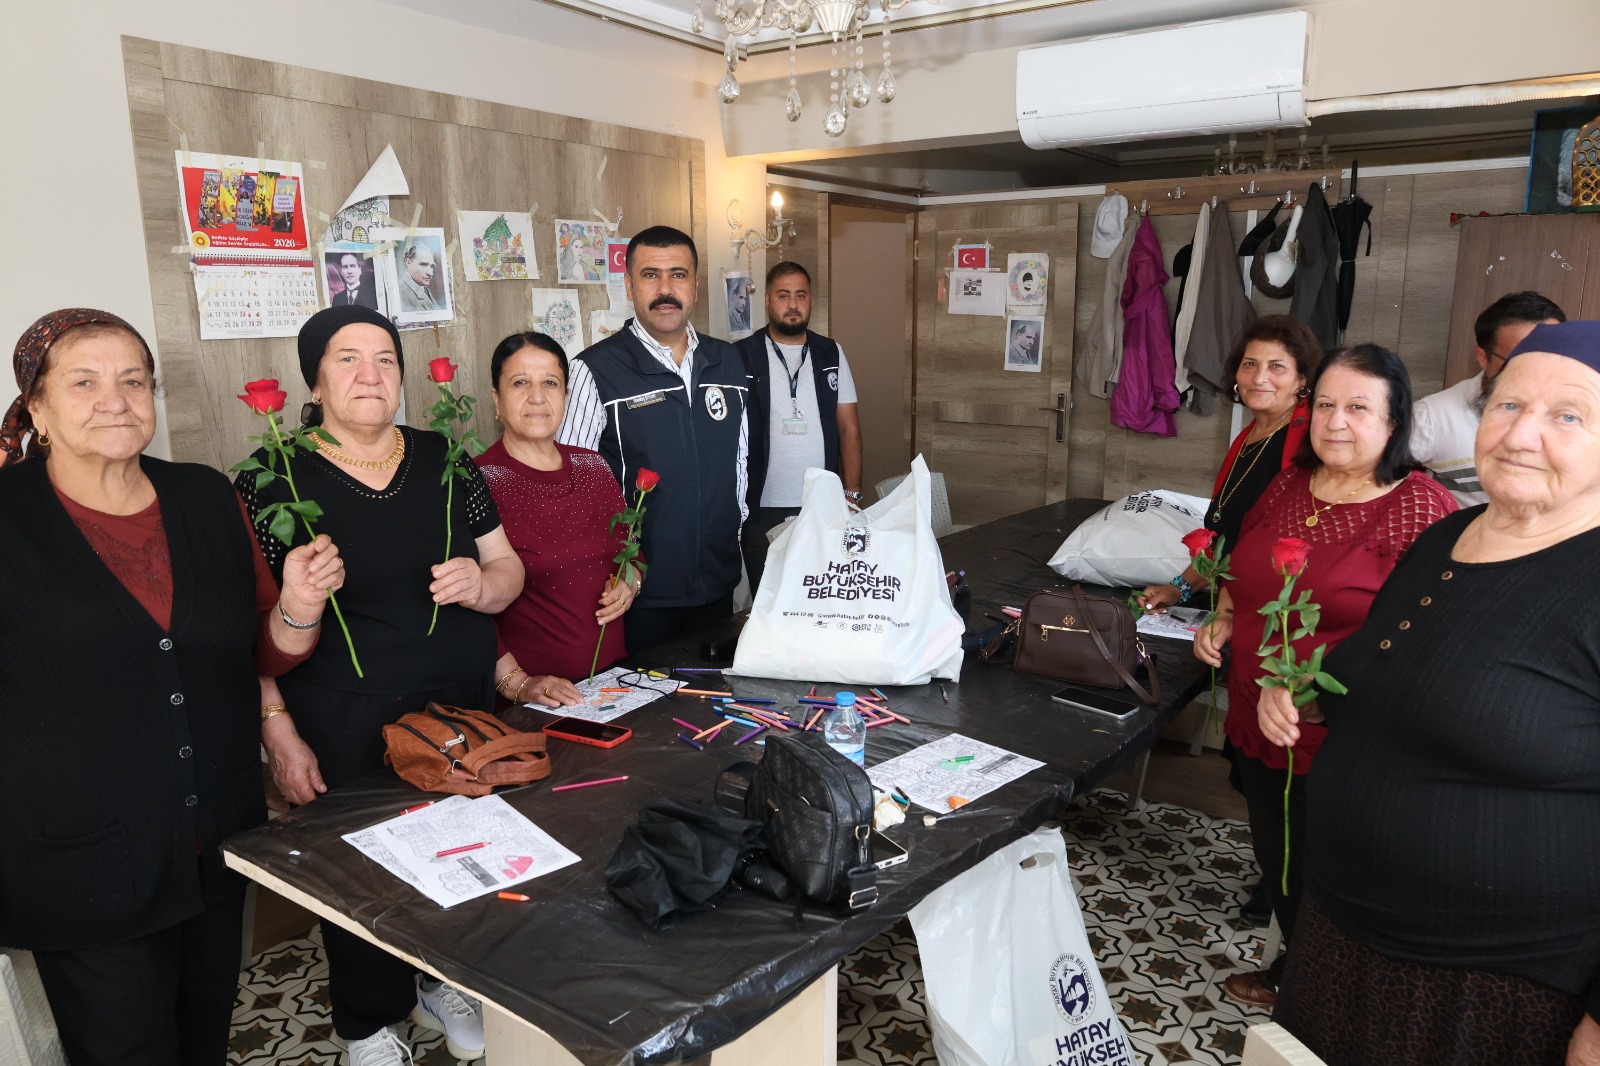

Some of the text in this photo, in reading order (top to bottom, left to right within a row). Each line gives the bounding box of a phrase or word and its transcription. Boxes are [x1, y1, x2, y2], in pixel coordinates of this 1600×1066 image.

[274, 238, 296, 248] 2026
[828, 560, 878, 575] HATAY
[802, 572, 901, 592] BÜYÜKŞEHİR
[807, 586, 895, 602] BELEDİYESİ
[1056, 1018, 1111, 1056] HATAY
